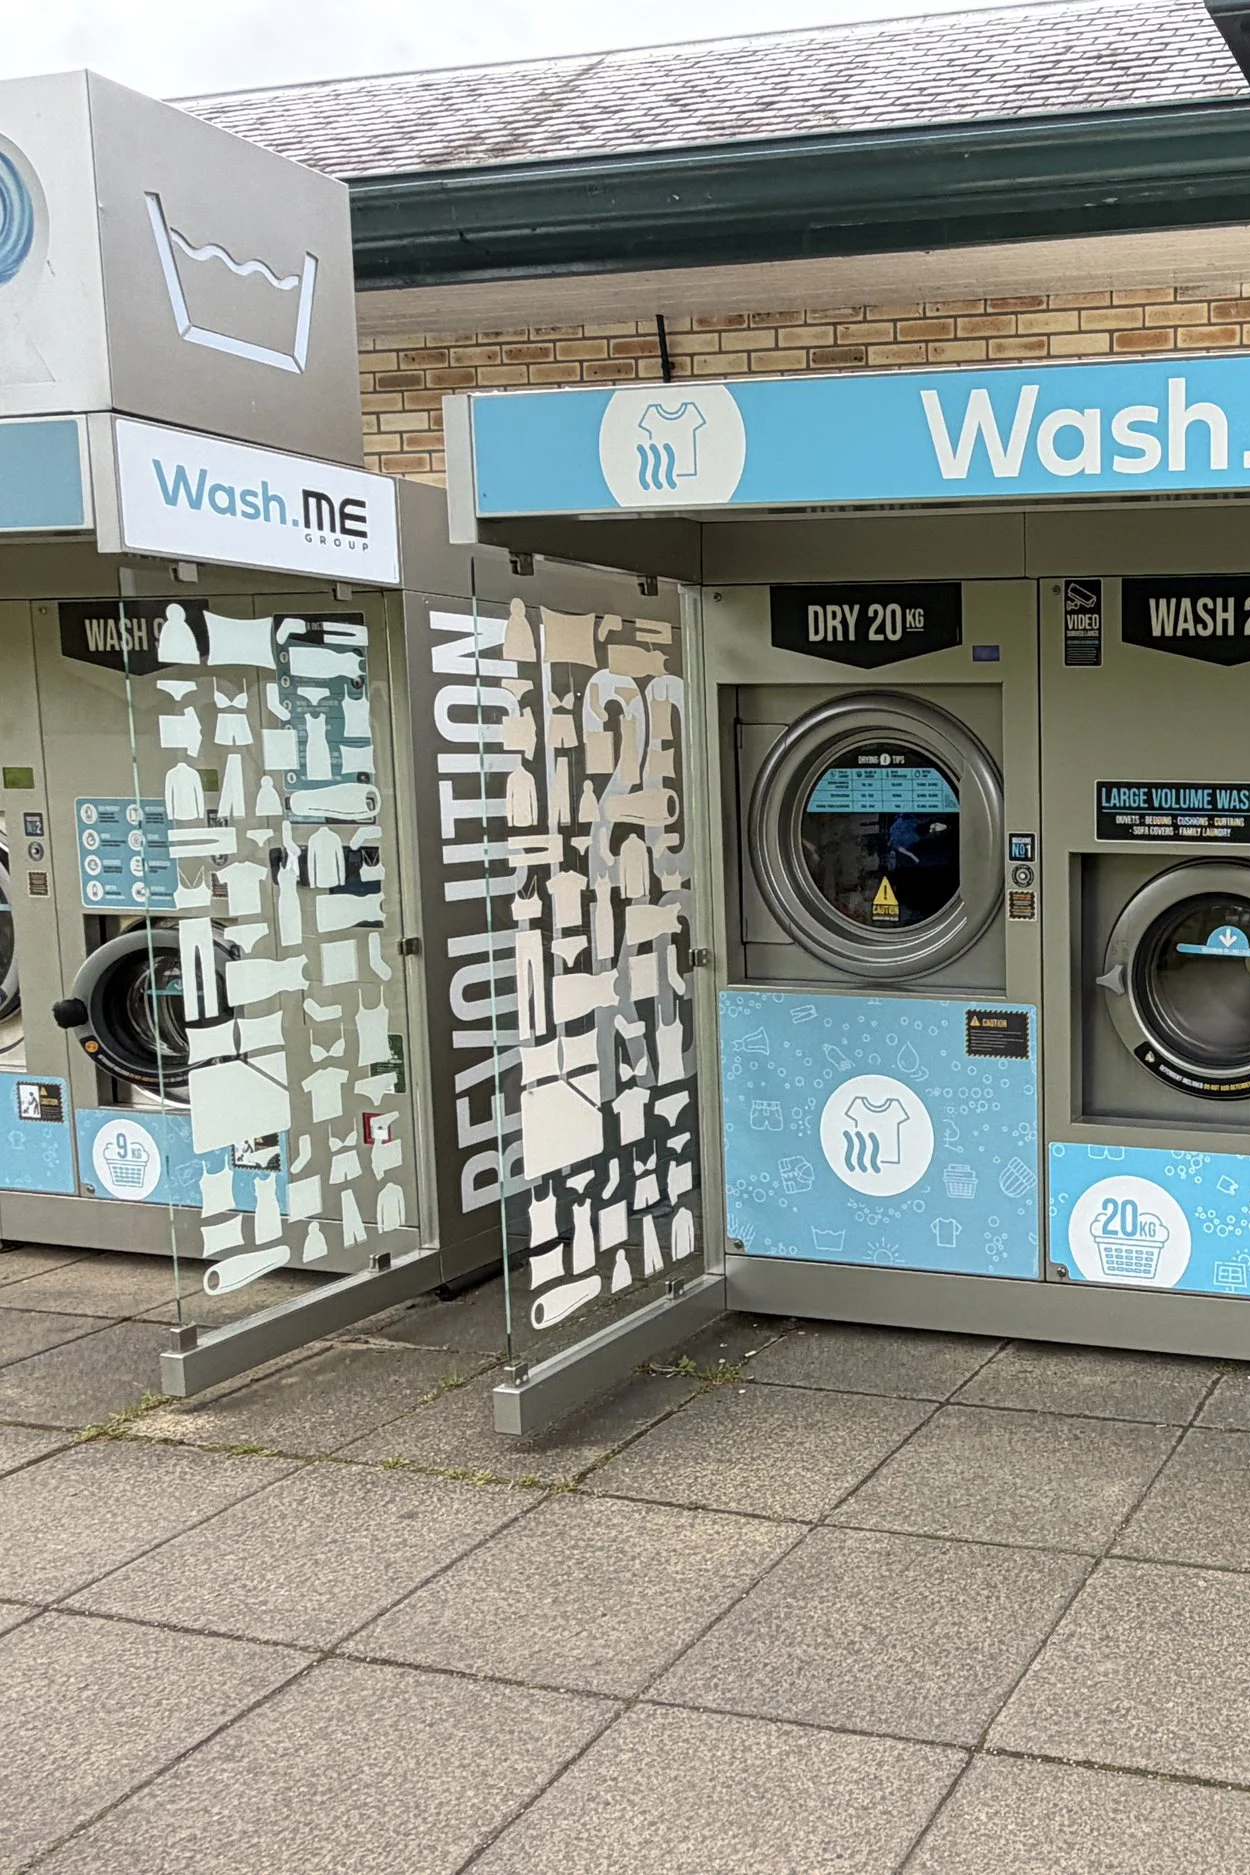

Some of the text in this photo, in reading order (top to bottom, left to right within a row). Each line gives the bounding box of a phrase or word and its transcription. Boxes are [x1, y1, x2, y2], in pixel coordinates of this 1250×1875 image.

[304, 533, 369, 552] GROUP
[808, 603, 860, 643] DRY
[868, 602, 902, 642] 20
[1066, 613, 1099, 630] VIDEO
[1149, 597, 1235, 637] WASH
[84, 618, 149, 652] WASH
[892, 755, 905, 764] TIPS
[1102, 787, 1148, 807] LARGE
[1152, 788, 1212, 809] VOLUME
[1116, 815, 1245, 827] DUVETS BEDDING CUSHIONS CURTAINS
[1133, 826, 1231, 838] SOFA COVERS FAMILY LAUNDRY
[116, 1132, 129, 1158] 9
